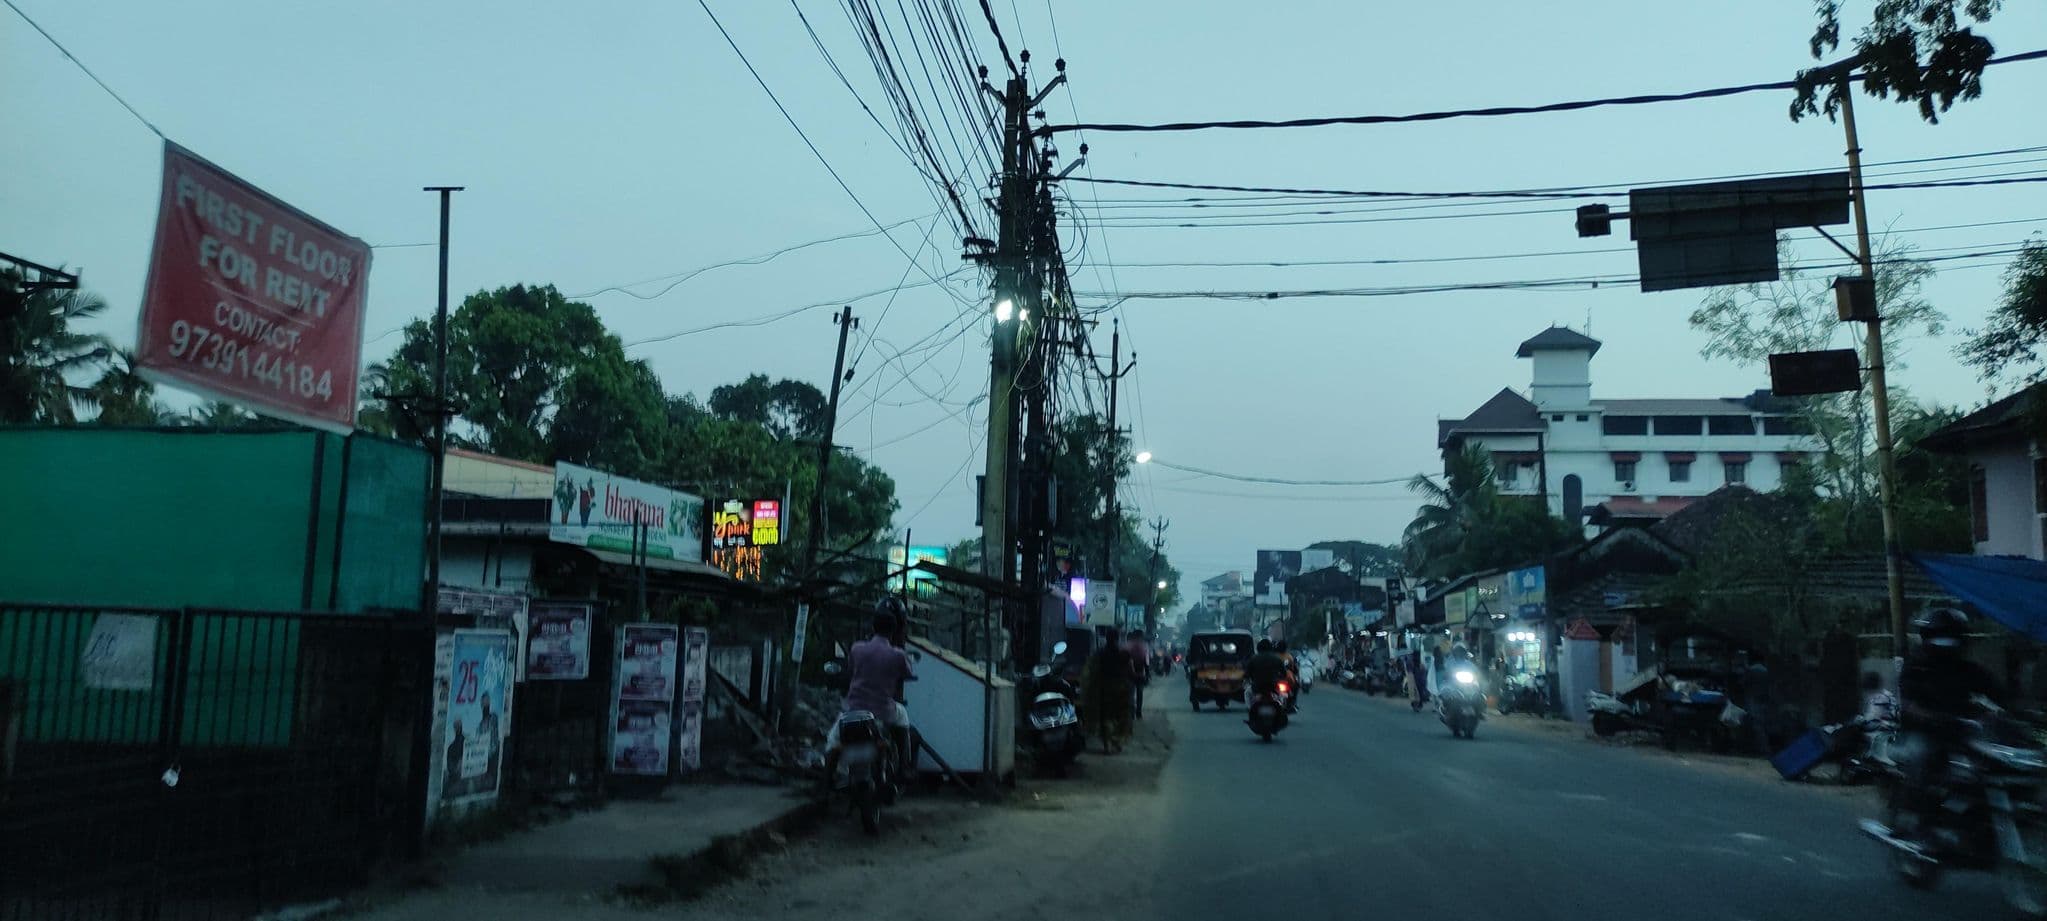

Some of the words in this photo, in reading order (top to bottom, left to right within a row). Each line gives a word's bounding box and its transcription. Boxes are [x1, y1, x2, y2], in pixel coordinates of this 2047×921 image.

[177, 174, 263, 243] FIRST
[269, 224, 351, 286] FLOOR
[198, 235, 258, 291] FOR
[266, 268, 328, 317] RENT
[168, 321, 332, 401] 9739144184
[605, 482, 664, 528] bhavana
[456, 659, 479, 705] 25
